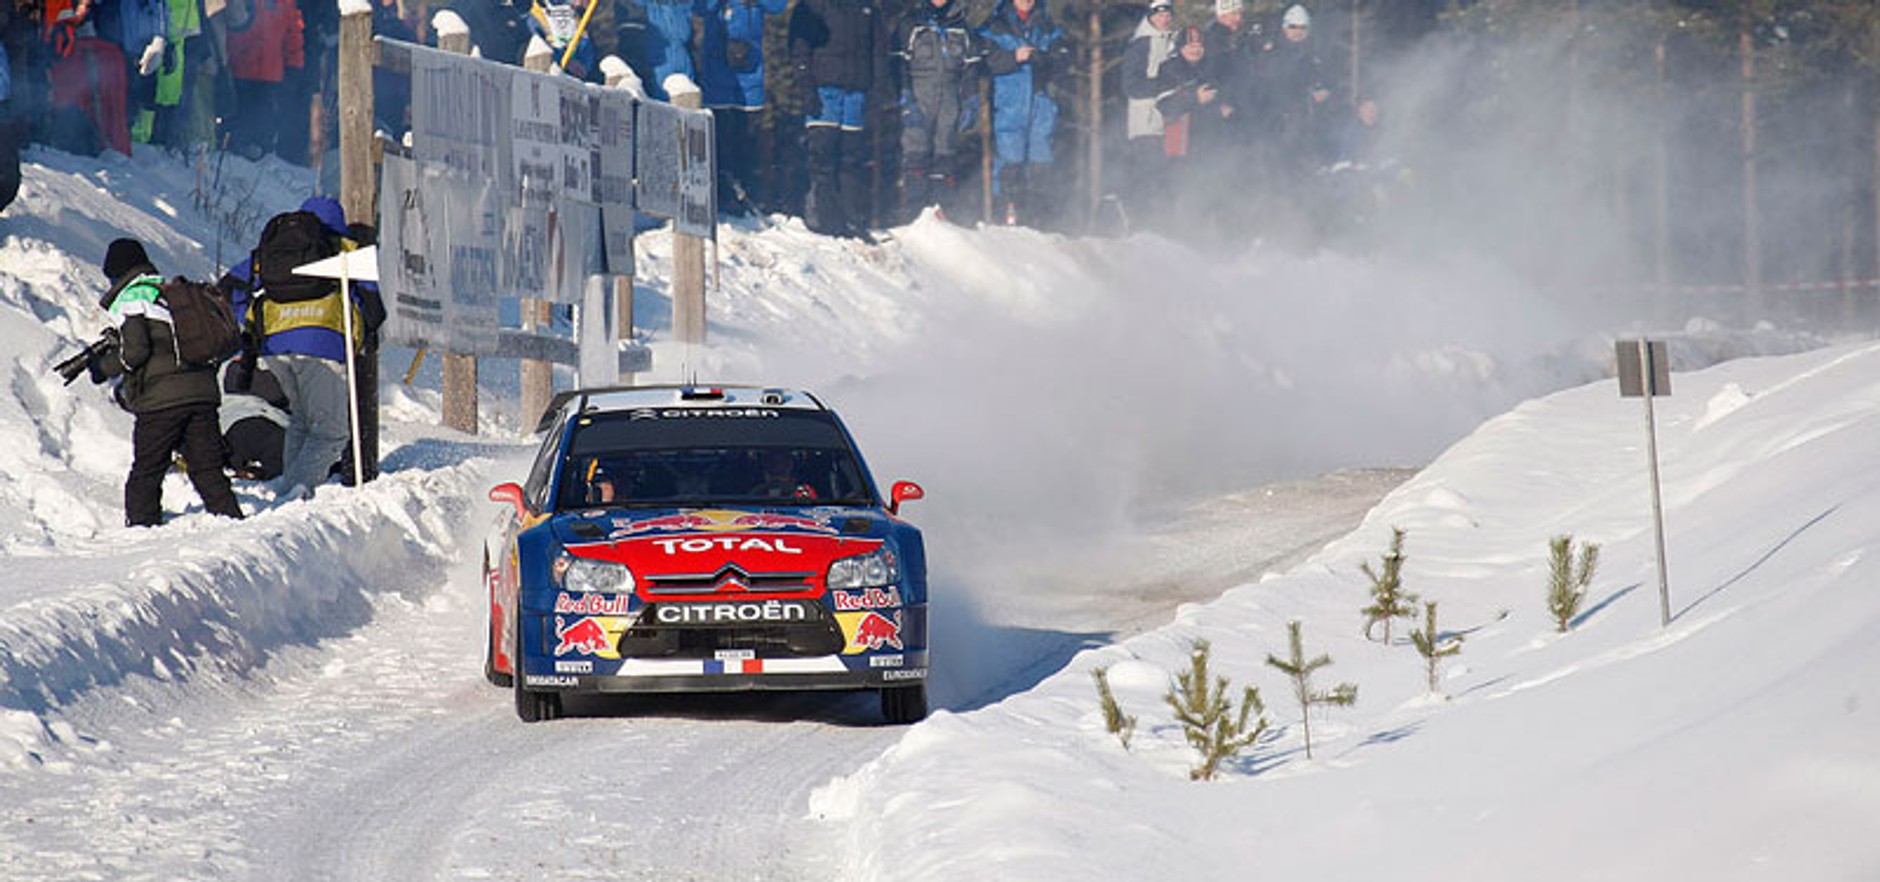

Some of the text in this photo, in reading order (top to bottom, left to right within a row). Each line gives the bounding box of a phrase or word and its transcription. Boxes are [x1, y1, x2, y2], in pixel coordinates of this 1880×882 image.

[279, 305, 325, 320] Media
[652, 537, 803, 555] TOTAL
[554, 592, 629, 614] Red Bull
[832, 588, 872, 611] Red
[657, 600, 805, 623] CITROËN
